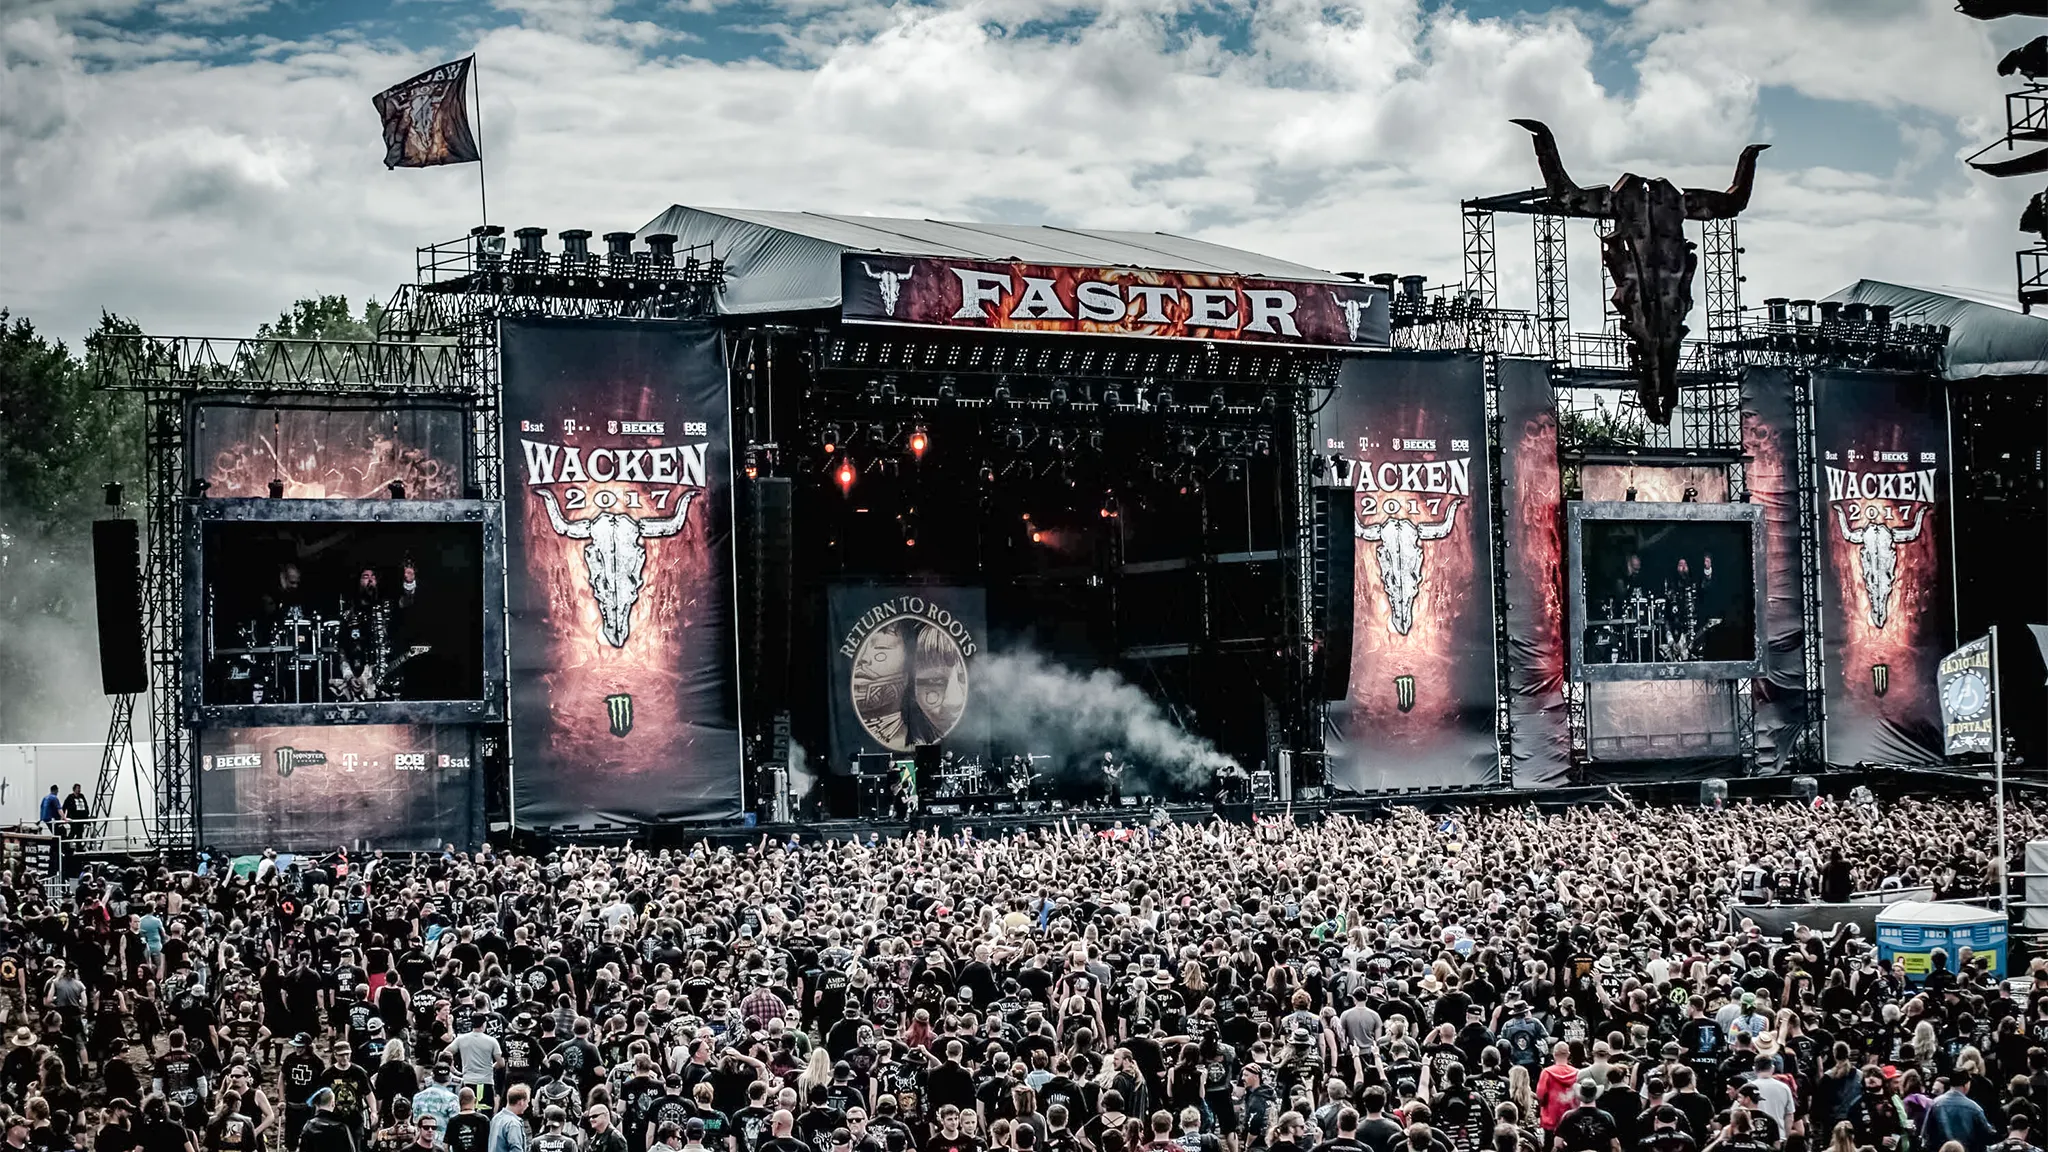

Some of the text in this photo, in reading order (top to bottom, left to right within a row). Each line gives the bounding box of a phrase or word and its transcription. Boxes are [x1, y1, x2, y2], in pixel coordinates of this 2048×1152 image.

[950, 267, 1302, 337] FASTER
[522, 420, 544, 432] 3sat
[622, 422, 664, 433] BECK'S
[1404, 440, 1436, 449] BECK'S
[520, 439, 709, 487] WACKEN
[1882, 453, 1908, 461] BECK'S
[1824, 465, 1937, 504] WACKEN
[565, 488, 671, 509] 2017
[1361, 497, 1442, 516] 2017
[1848, 504, 1911, 521] 2017
[839, 596, 977, 659] RETURN TO ROOTS
[217, 754, 261, 768] BECK'S
[395, 754, 425, 765] BOB!
[438, 754, 470, 768] 3sat
